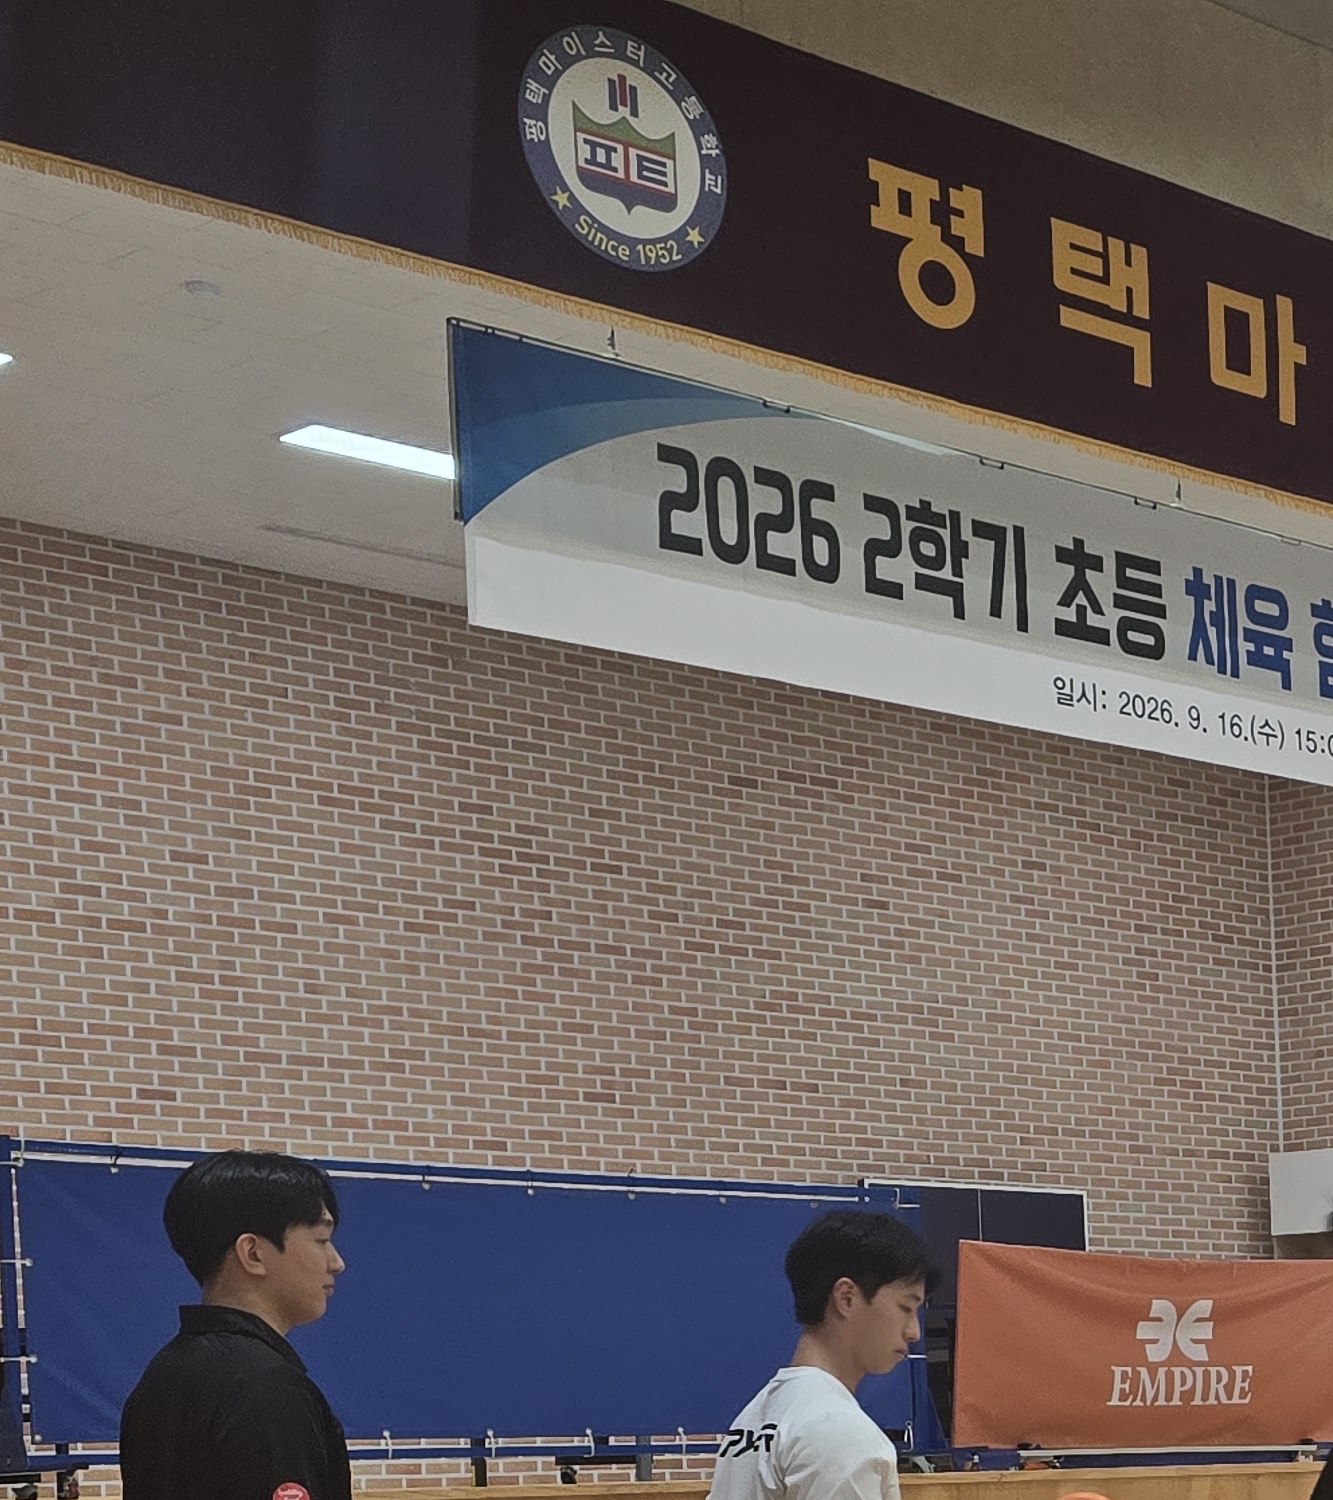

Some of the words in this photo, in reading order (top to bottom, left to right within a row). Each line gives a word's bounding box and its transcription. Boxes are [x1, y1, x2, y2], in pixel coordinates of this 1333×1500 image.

[575, 215, 630, 261] Since
[636, 240, 682, 265] 1952
[657, 442, 841, 584] 2026
[863, 492, 1028, 633] 2학기
[1054, 537, 1167, 661] 초등
[1185, 566, 1293, 691] 체육
[1053, 676, 1107, 712] 일시:
[1119, 691, 1179, 727] 2026.
[1188, 706, 1207, 733] 9.
[1218, 713, 1284, 750] 16.(수)
[1106, 1366, 1253, 1406] EMPIRE
